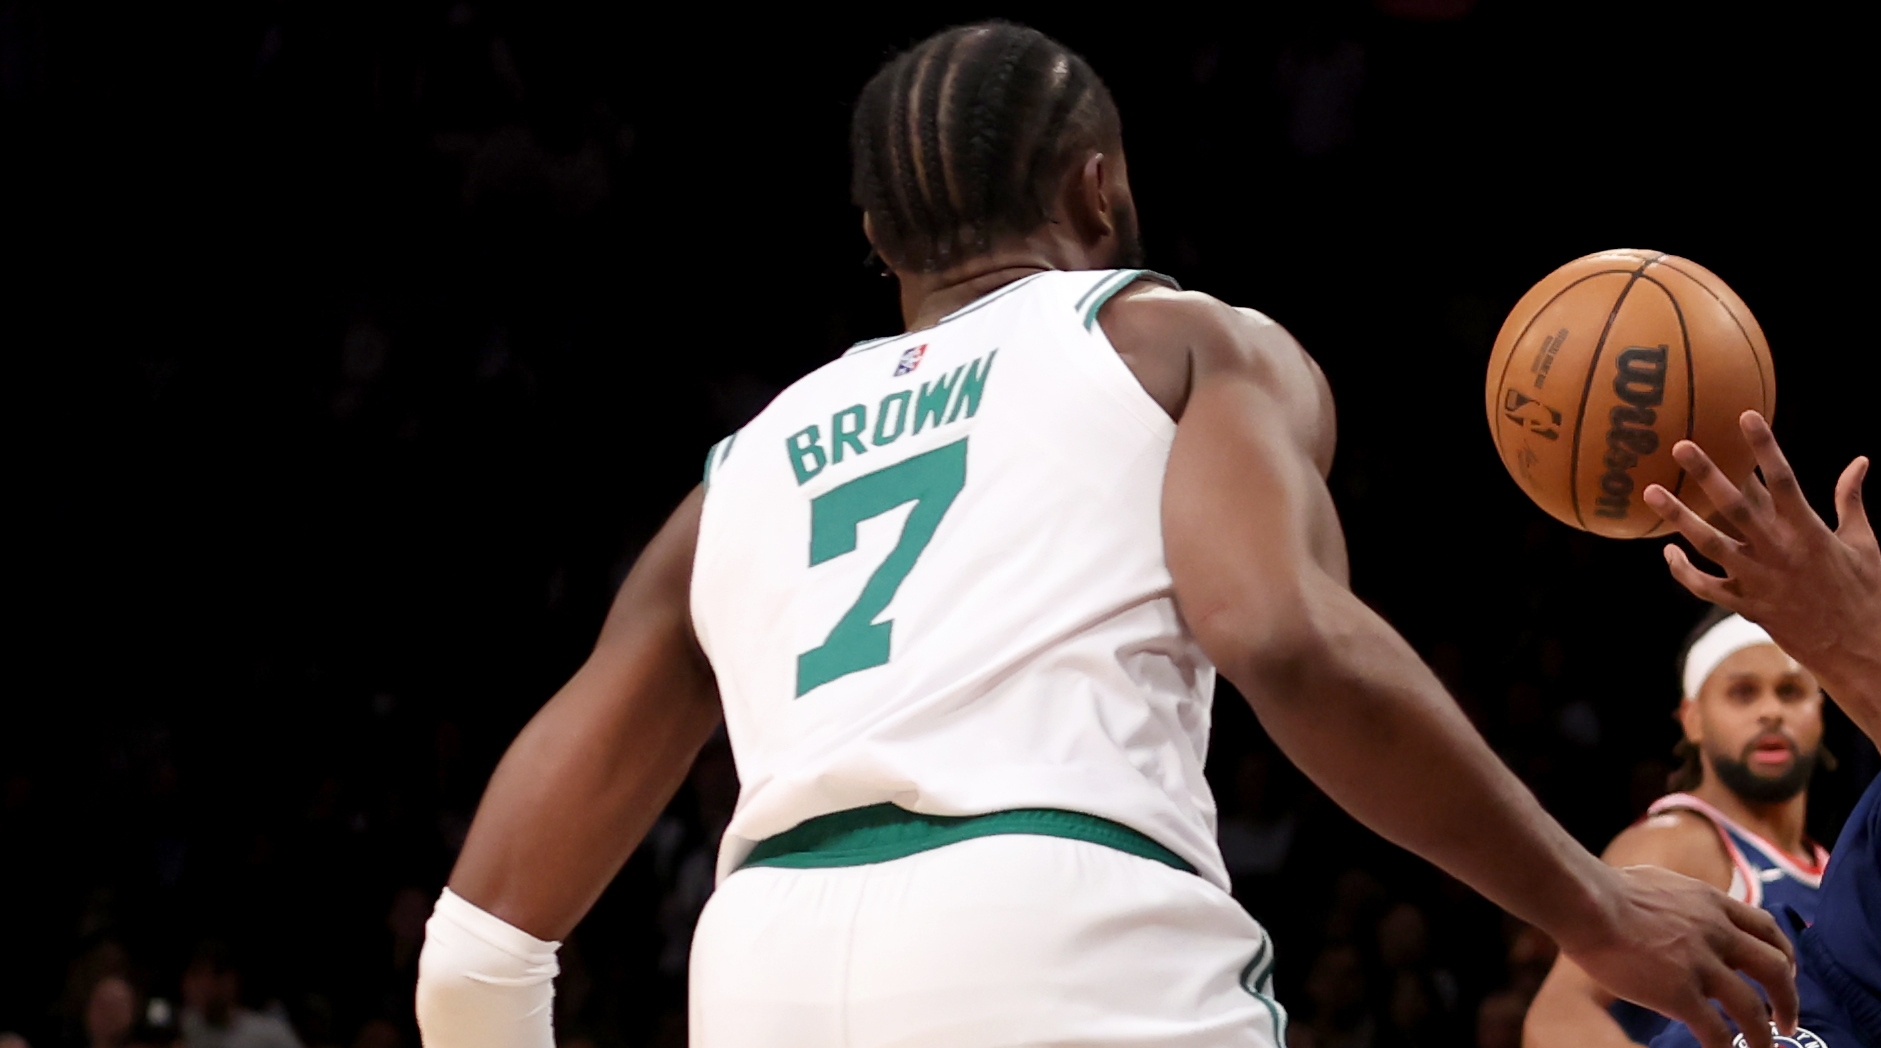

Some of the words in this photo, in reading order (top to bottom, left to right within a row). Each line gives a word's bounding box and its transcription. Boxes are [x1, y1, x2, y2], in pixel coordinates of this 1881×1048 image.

[786, 347, 998, 486] BROWN
[1594, 344, 1669, 519] Wilson
[794, 436, 968, 700] 7
